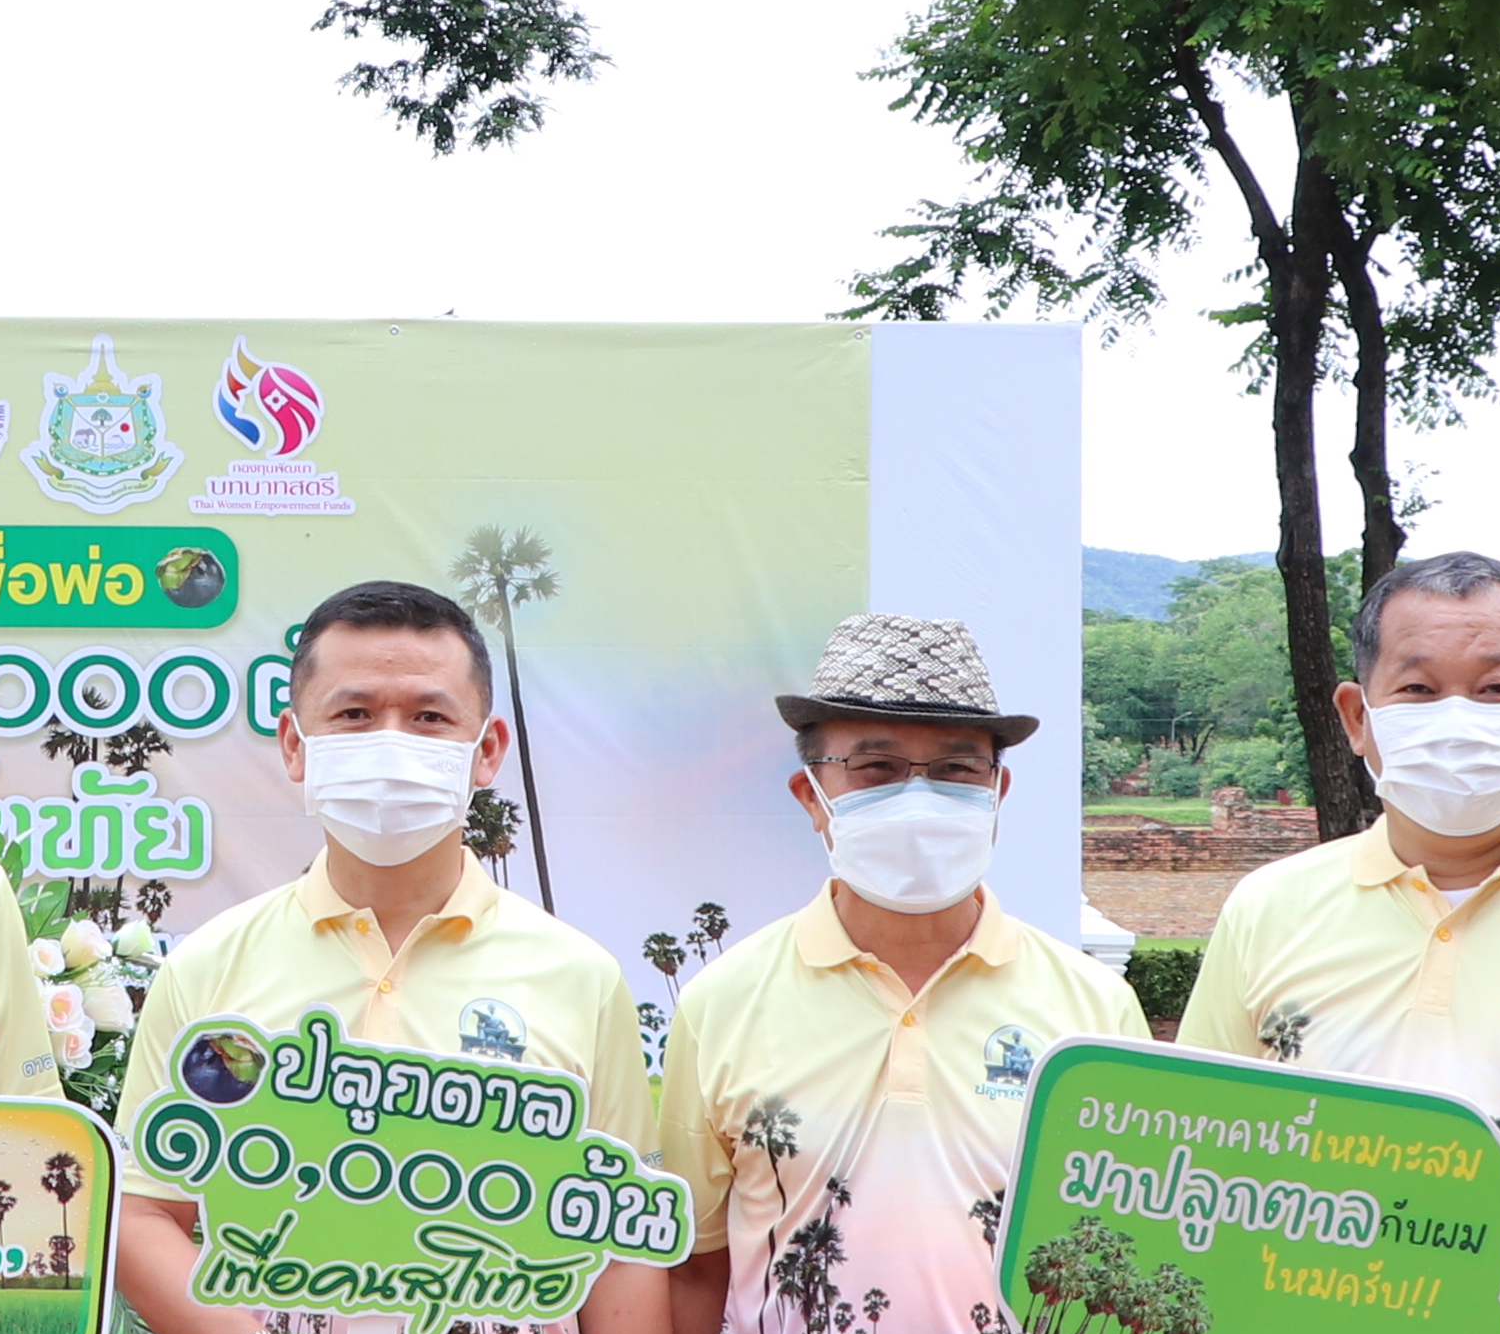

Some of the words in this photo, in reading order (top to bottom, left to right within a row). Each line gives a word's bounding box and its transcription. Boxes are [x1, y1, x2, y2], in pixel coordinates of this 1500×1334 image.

[193, 500, 214, 509] Thai
[217, 500, 252, 510] Women
[254, 500, 321, 512] Empowerment
[323, 501, 351, 510] Funds
[210, 476, 335, 496] บทบาทสตรี
[271, 1017, 577, 1139] ปลูกตาล
[143, 1101, 537, 1227] ๑๐,๐๐๐
[549, 1144, 680, 1254] ต้น
[199, 1212, 597, 1334] เพื่อคนสุโขทัย
[1261, 1244, 1442, 1320] ไหมครับ!!
